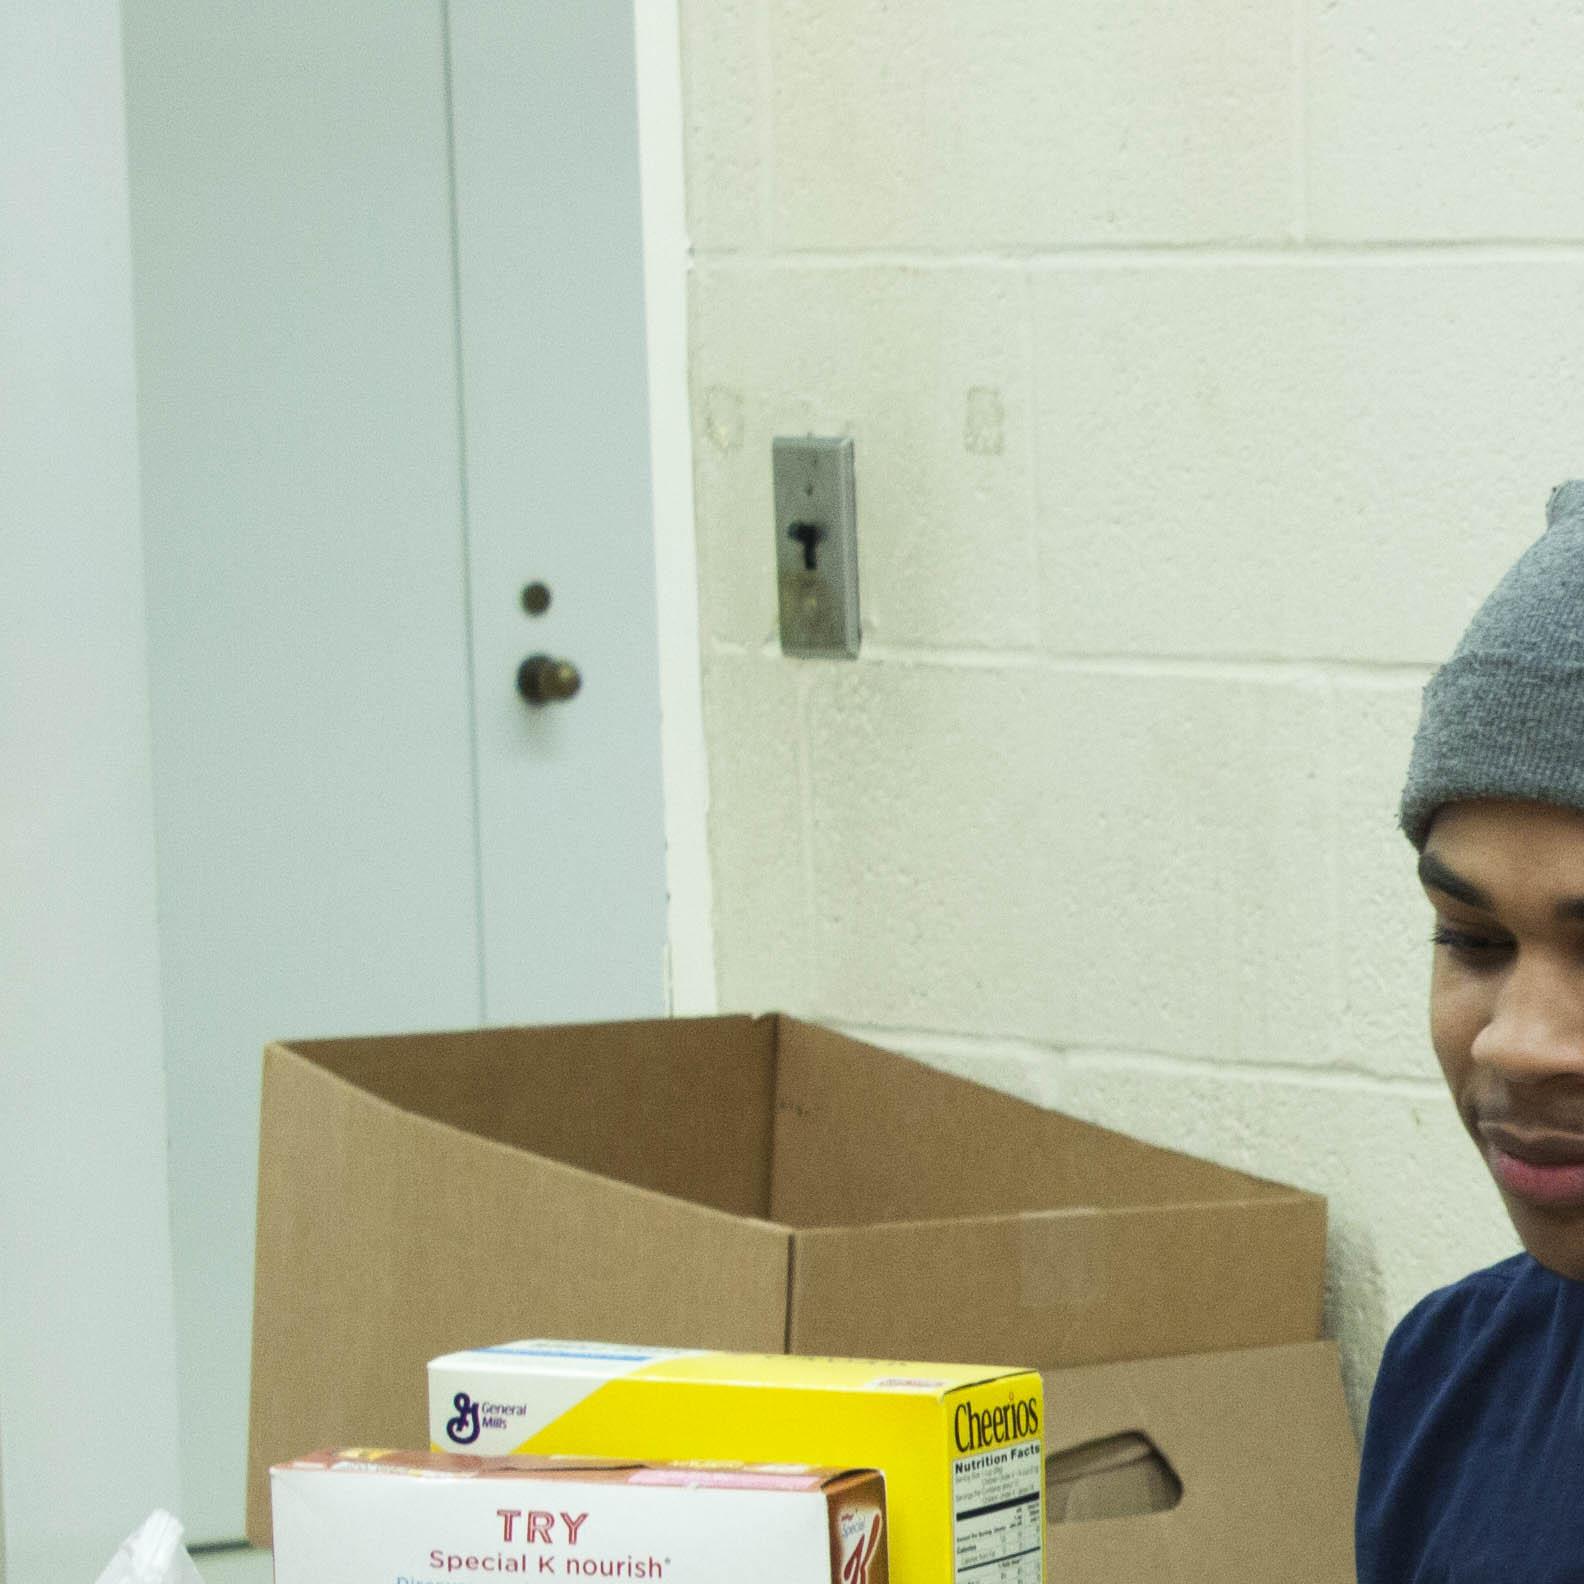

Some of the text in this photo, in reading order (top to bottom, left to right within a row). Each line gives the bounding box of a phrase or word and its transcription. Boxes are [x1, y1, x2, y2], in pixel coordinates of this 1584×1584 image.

[481, 1401, 527, 1416] General
[954, 1392, 1039, 1453] Cheerios
[481, 1416, 508, 1430] Mills
[955, 1443, 1040, 1475] Nutrition Facts
[496, 1509, 589, 1546] TRY
[429, 1550, 527, 1574] Special
[538, 1554, 555, 1574] K
